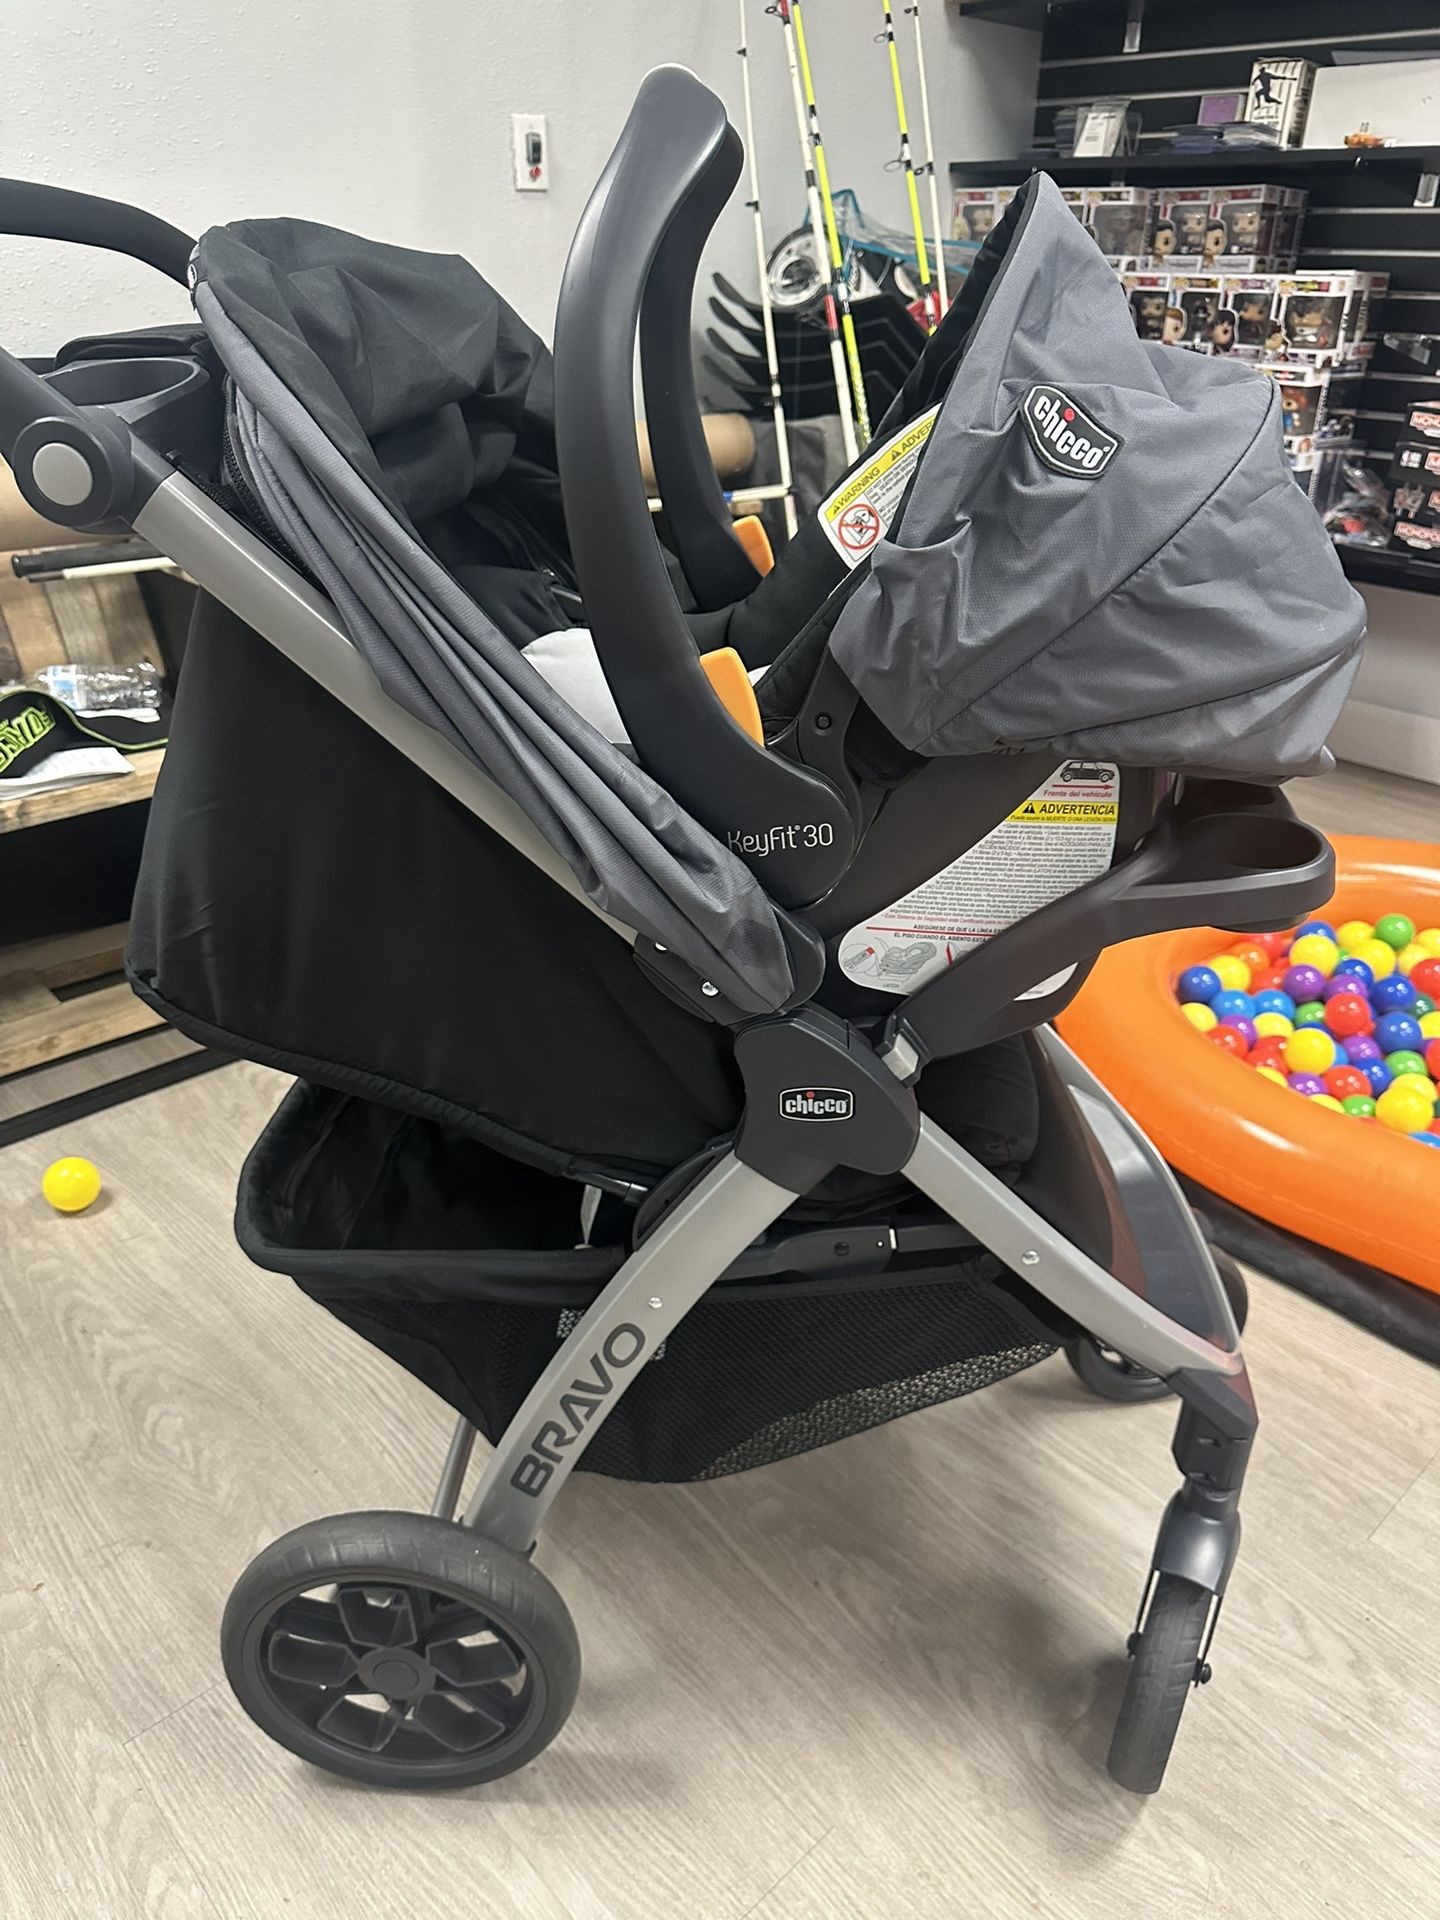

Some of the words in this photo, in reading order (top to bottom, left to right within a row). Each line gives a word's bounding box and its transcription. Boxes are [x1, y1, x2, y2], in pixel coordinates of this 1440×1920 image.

[1034, 395, 1104, 468] chicco
[837, 467, 880, 506] WARNING
[1039, 803, 1115, 815] ADVERTENCIA
[803, 822, 834, 848] 30
[785, 1091, 847, 1115] chicco
[509, 1322, 646, 1497] BRAVO
